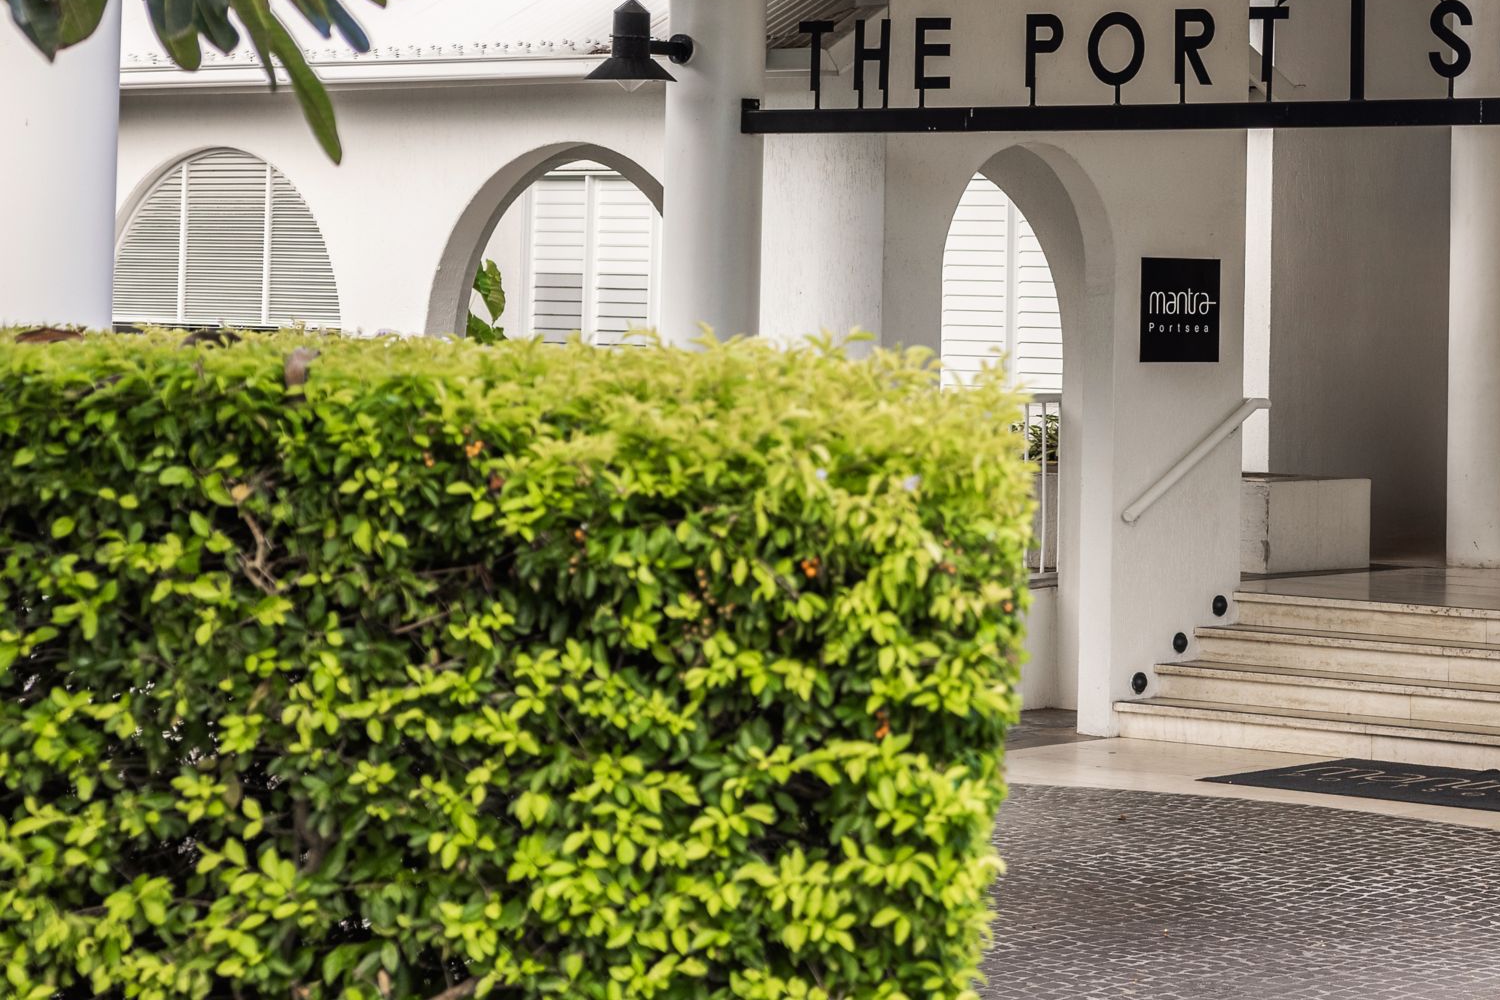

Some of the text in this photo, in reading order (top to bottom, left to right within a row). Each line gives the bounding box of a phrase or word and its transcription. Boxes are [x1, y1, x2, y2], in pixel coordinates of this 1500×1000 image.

[800, 18, 952, 91] THE
[1026, 7, 1289, 88] PORT
[1149, 287, 1217, 315] mantra
[1148, 322, 1209, 333] Portsea
